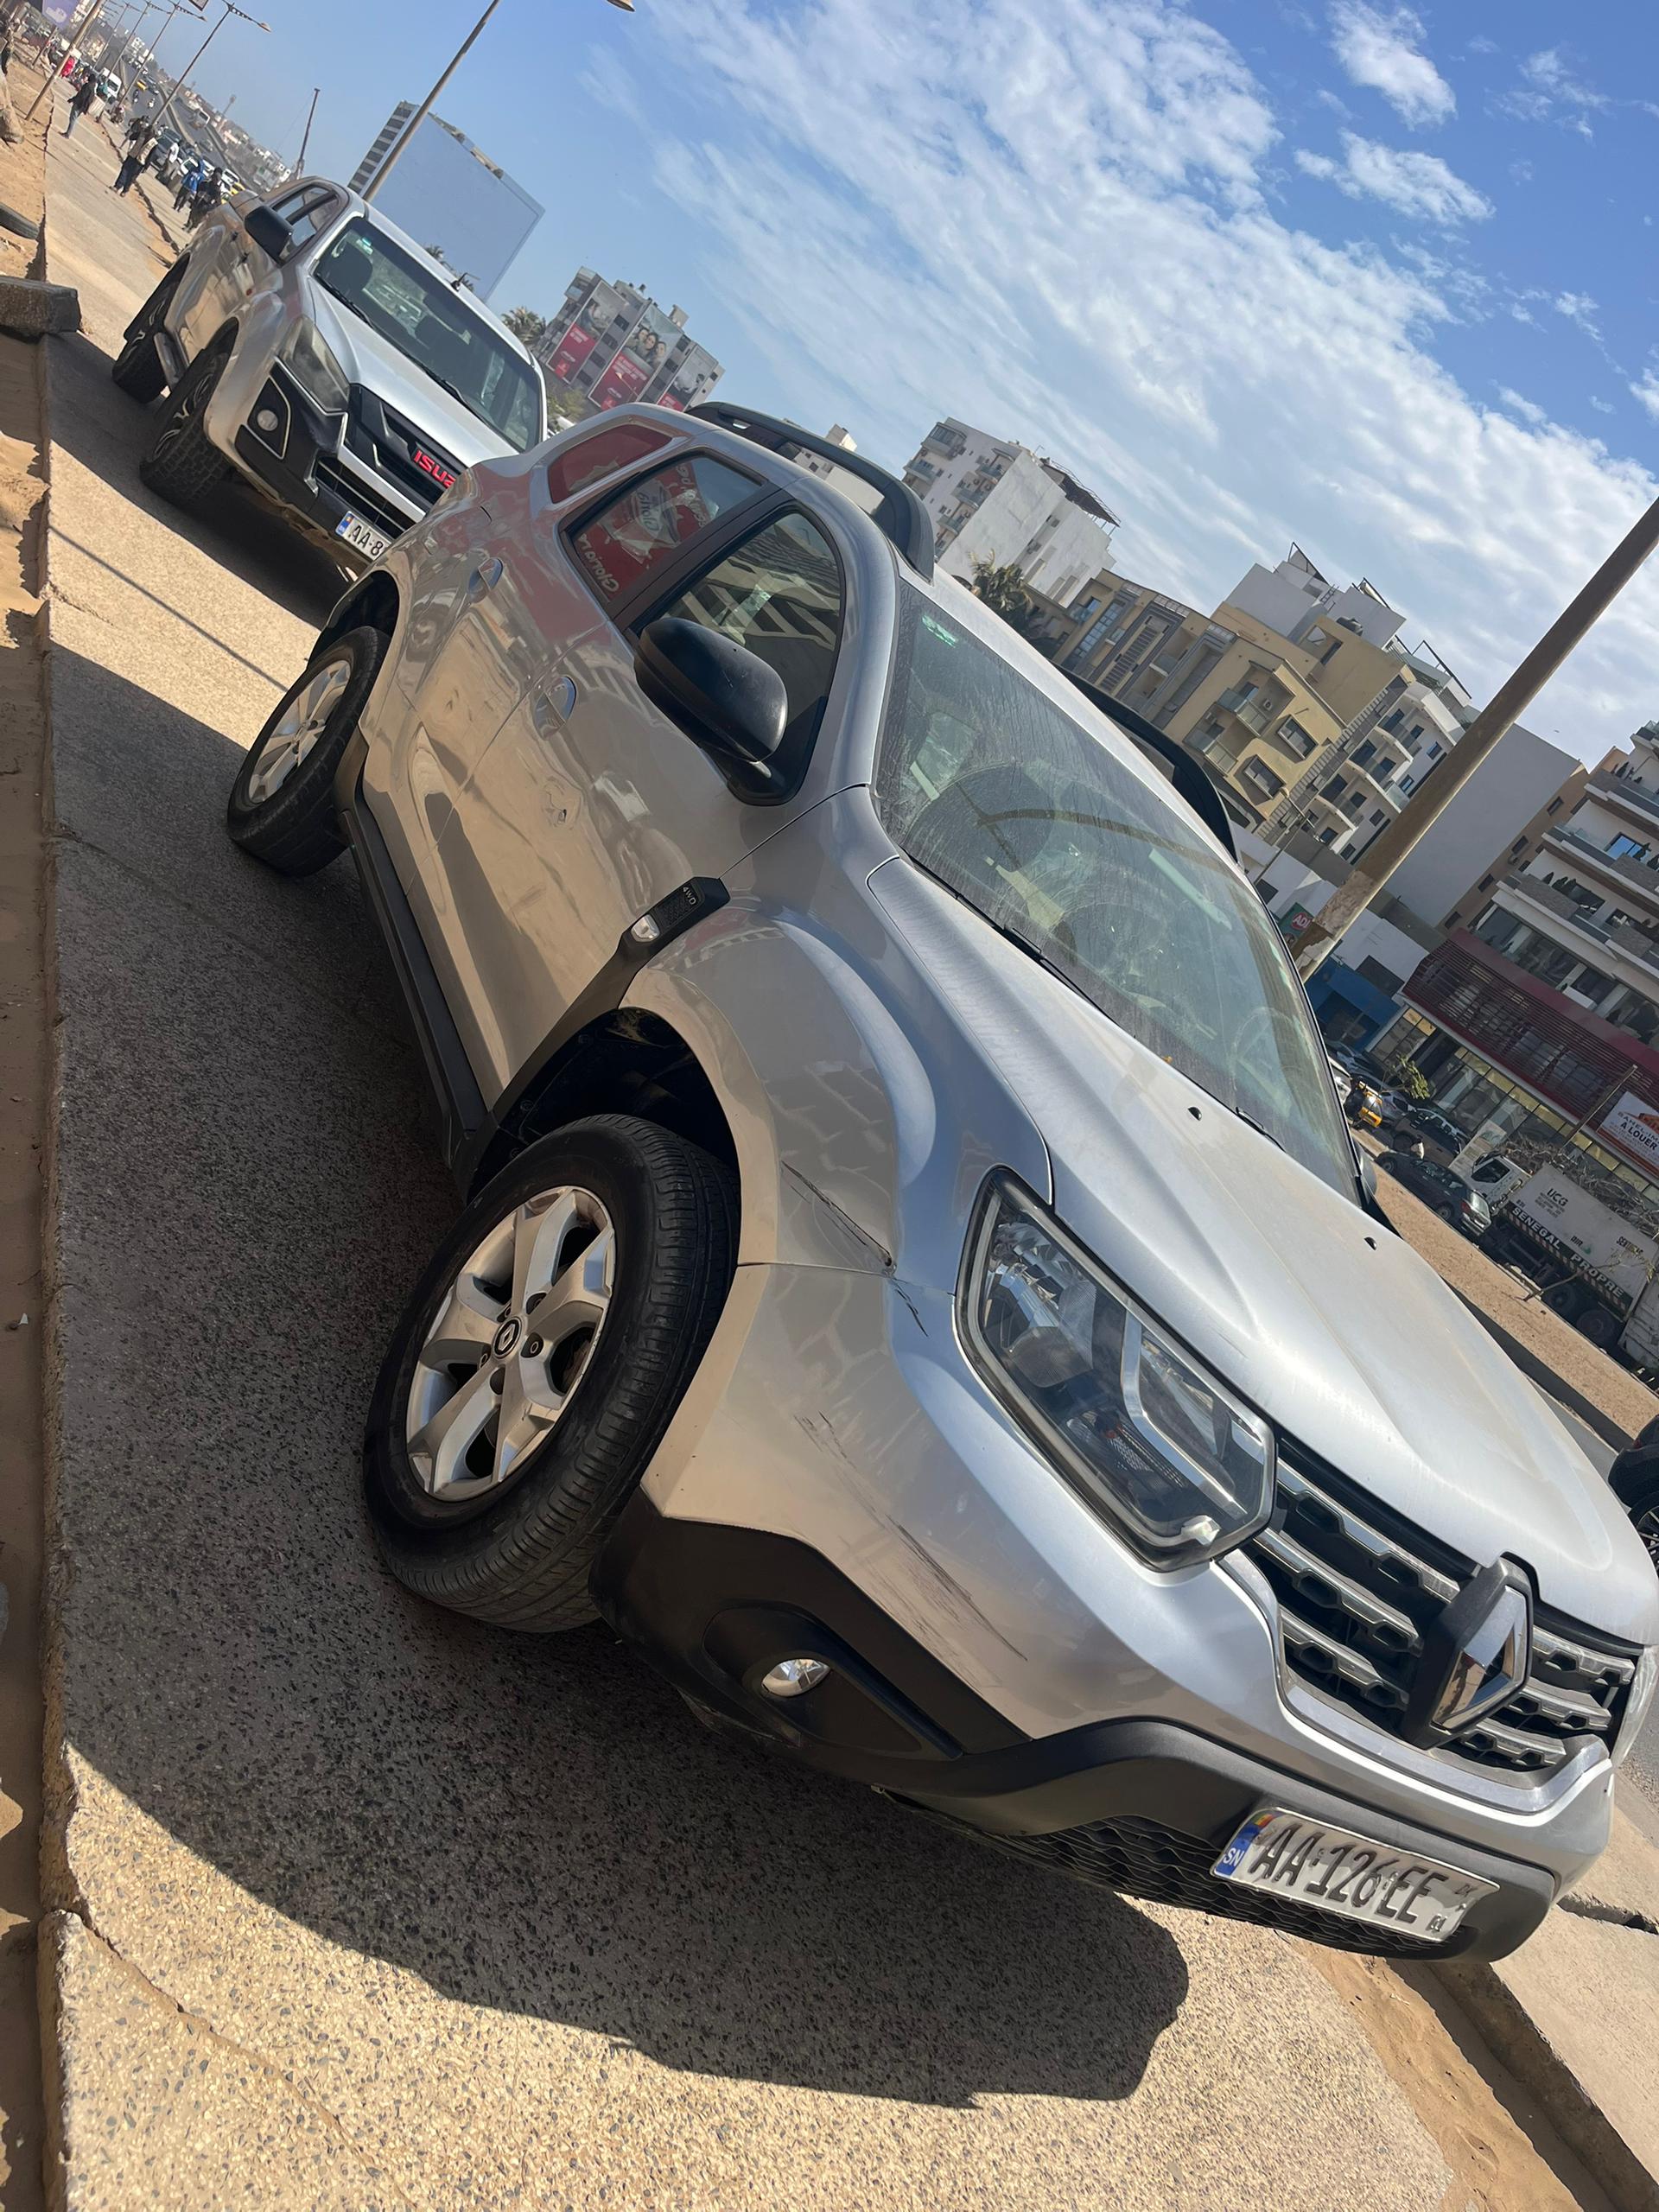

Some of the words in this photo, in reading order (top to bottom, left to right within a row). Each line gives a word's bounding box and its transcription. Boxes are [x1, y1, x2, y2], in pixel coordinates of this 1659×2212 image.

[414, 449, 456, 490] ISUZ
[683, 886, 697, 906] 4WD
[1628, 1126, 1658, 1150] LOUER
[1547, 1188, 1568, 1207] UCG
[1512, 1206, 1561, 1249] SENEGAL
[1570, 1253, 1624, 1297] PROPRE
[1223, 1847, 1245, 1867] SN
